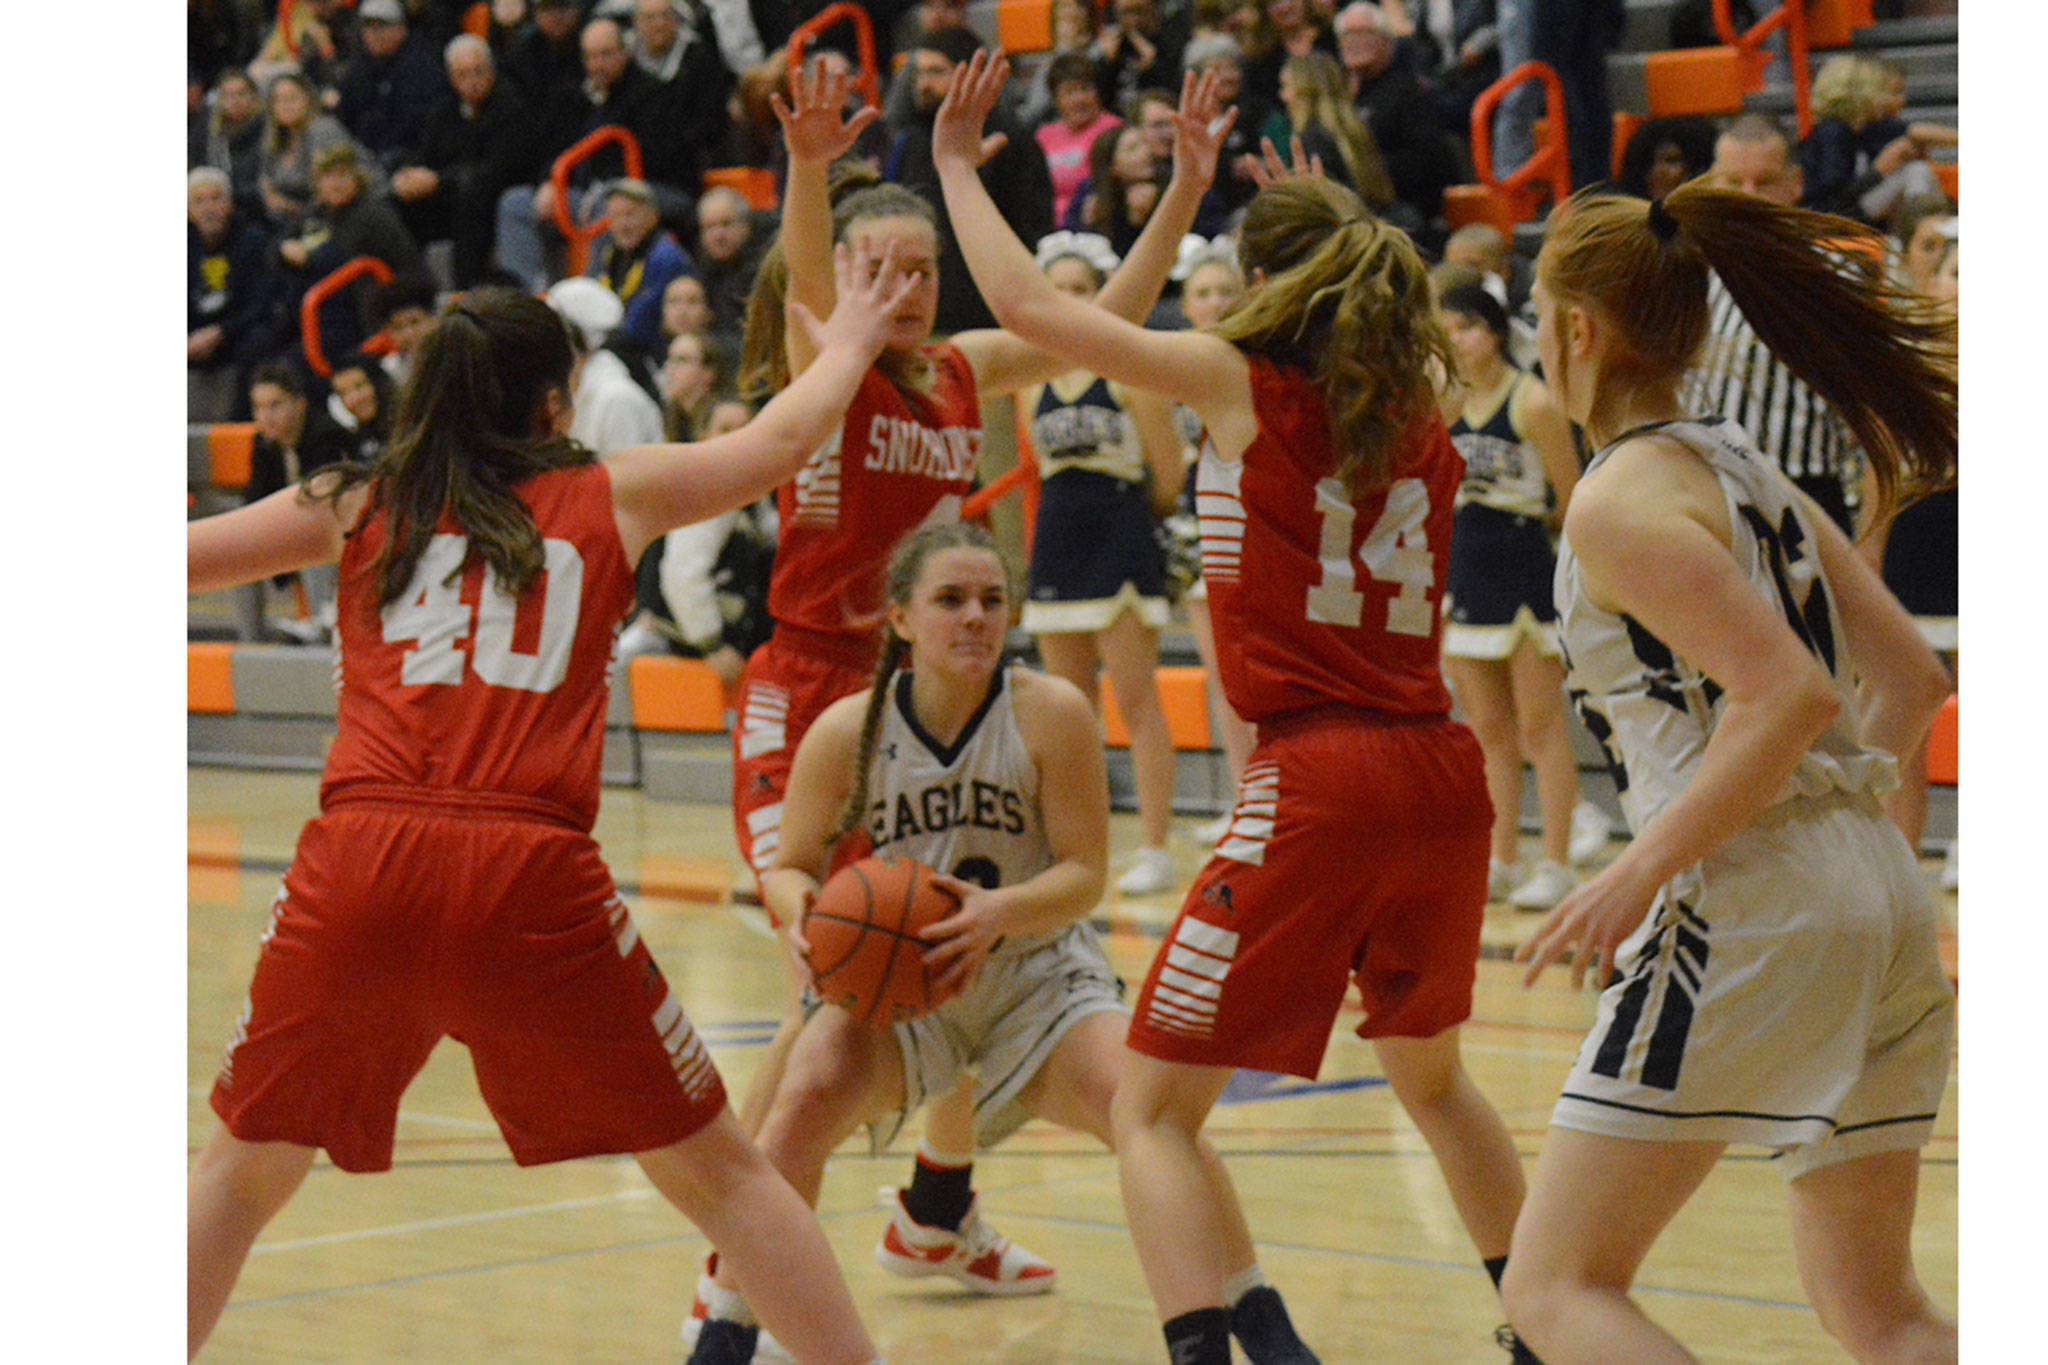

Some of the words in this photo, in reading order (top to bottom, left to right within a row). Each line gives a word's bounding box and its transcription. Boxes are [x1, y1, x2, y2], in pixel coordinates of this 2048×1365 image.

[380, 533, 584, 693] 40
[1306, 477, 1435, 638] 14
[871, 779, 1024, 849] EAGLES
